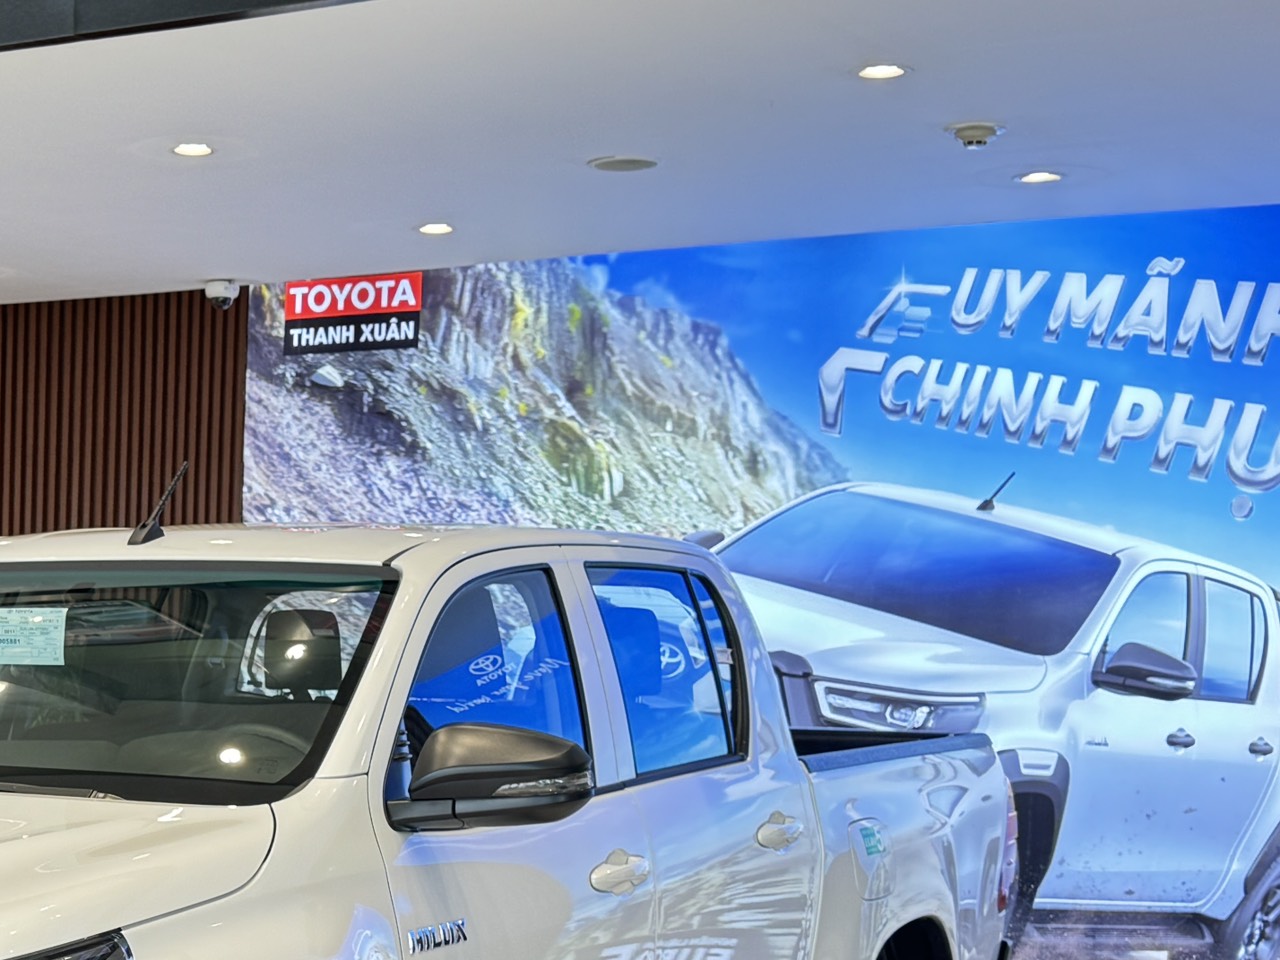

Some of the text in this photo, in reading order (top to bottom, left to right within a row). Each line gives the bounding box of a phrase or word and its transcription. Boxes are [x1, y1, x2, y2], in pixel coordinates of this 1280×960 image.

[289, 278, 417, 315] TOYOTA
[289, 317, 416, 347] THANH XUÂN
[879, 355, 1100, 456] CHINH
[407, 918, 468, 955] HILUX
